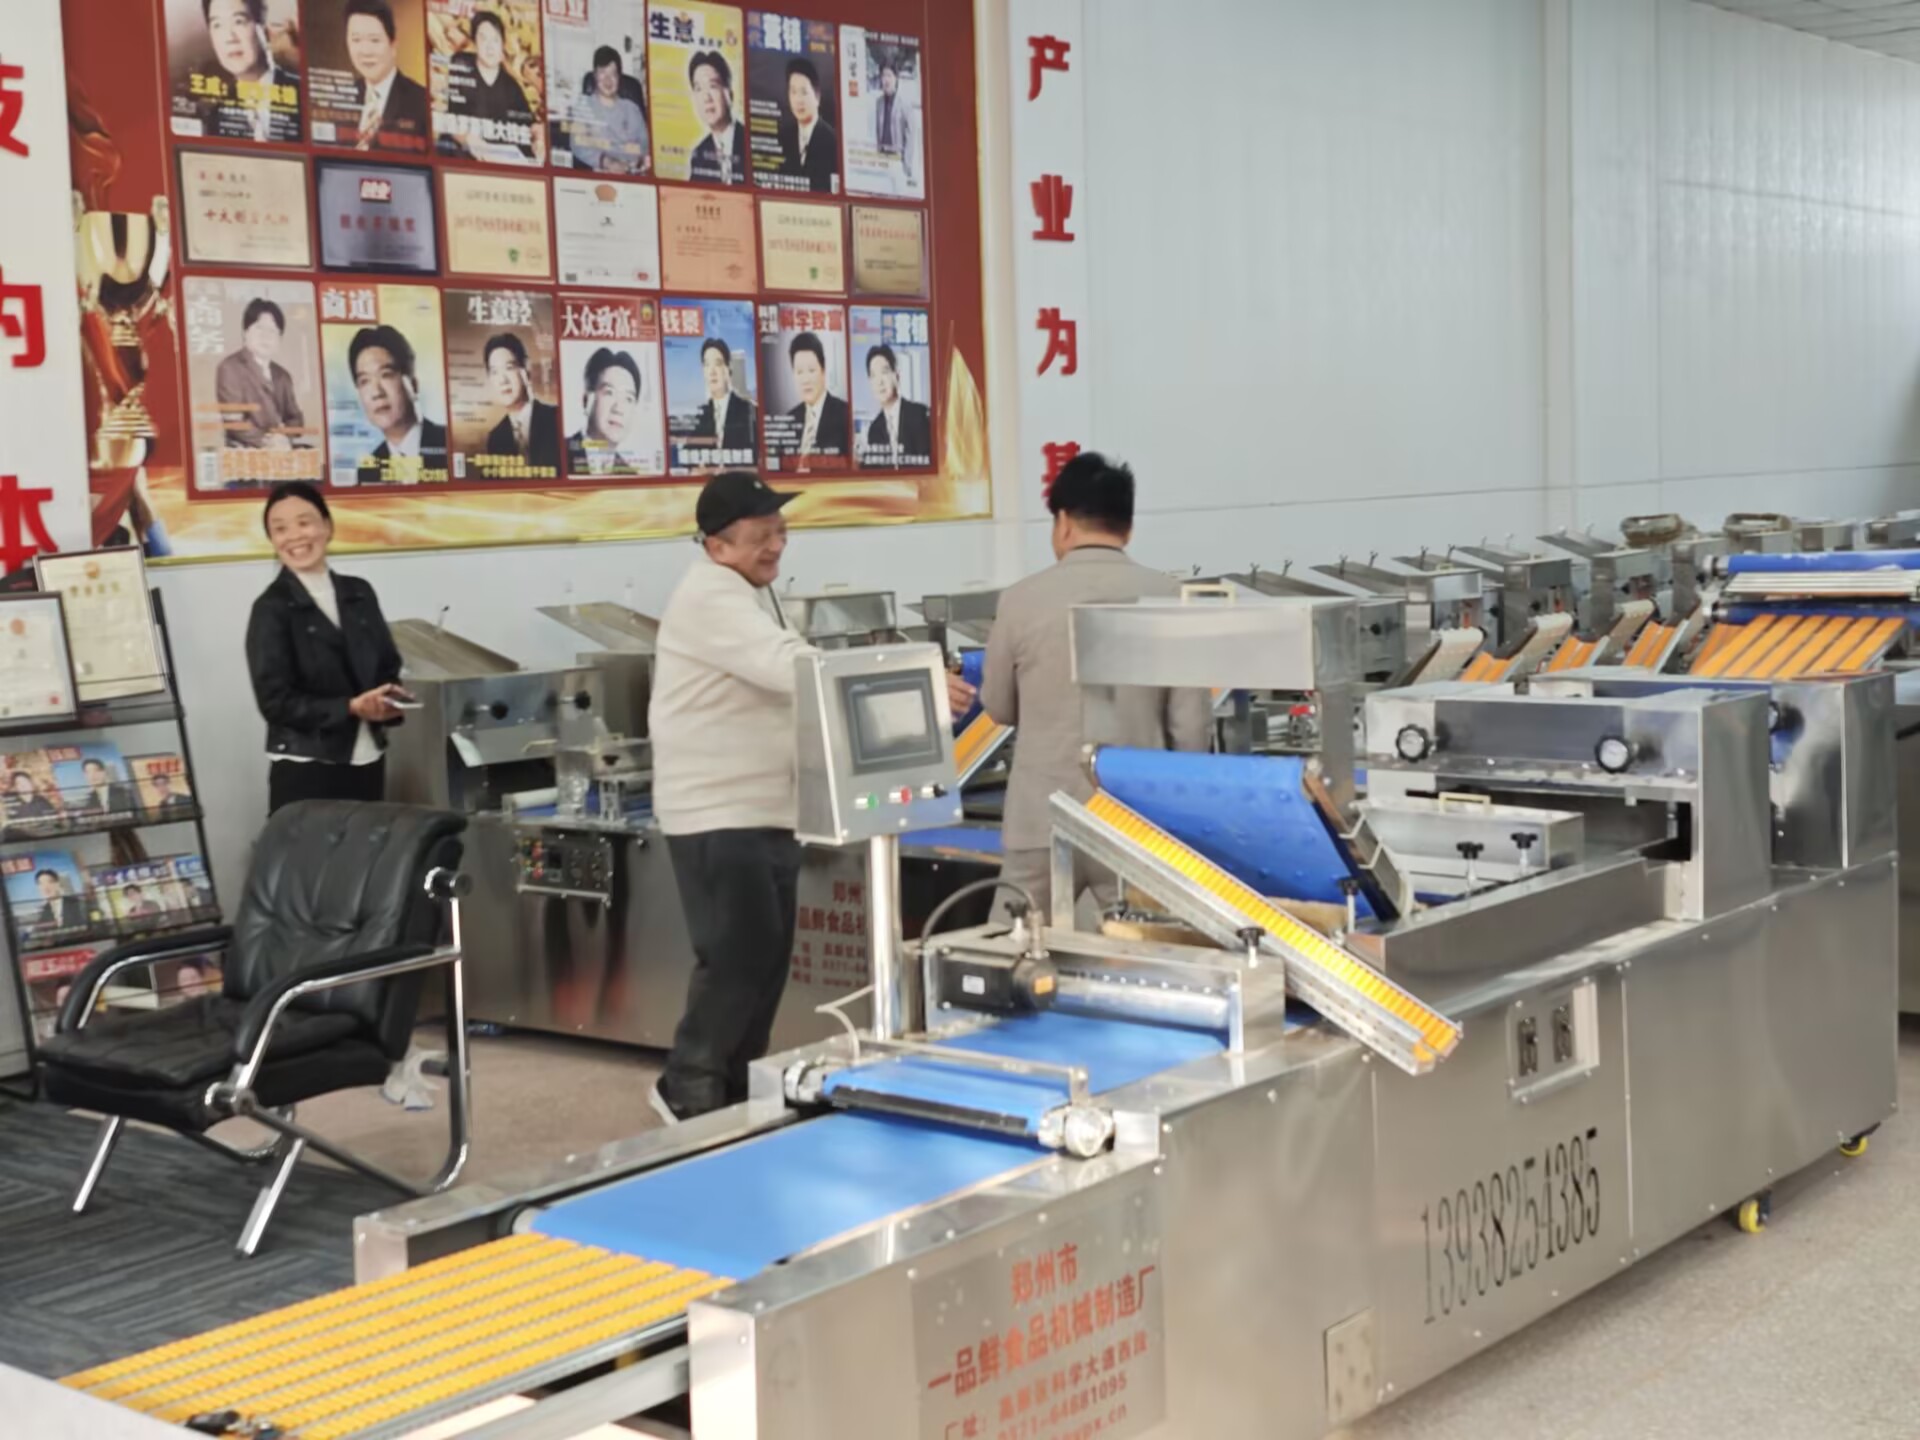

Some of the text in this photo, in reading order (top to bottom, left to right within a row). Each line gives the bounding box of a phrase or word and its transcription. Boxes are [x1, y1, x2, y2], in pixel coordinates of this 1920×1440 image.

[650, 12, 694, 44] 生意
[322, 288, 376, 320] 商道
[467, 295, 533, 327] 生意经
[561, 305, 632, 338] 大众致富
[833, 881, 865, 905] 郑州
[1421, 1126, 1600, 1326] 13938254385
[1010, 1242, 1078, 1306] 郑州市
[928, 1264, 1155, 1397] 一品鲜食品机械制造厂
